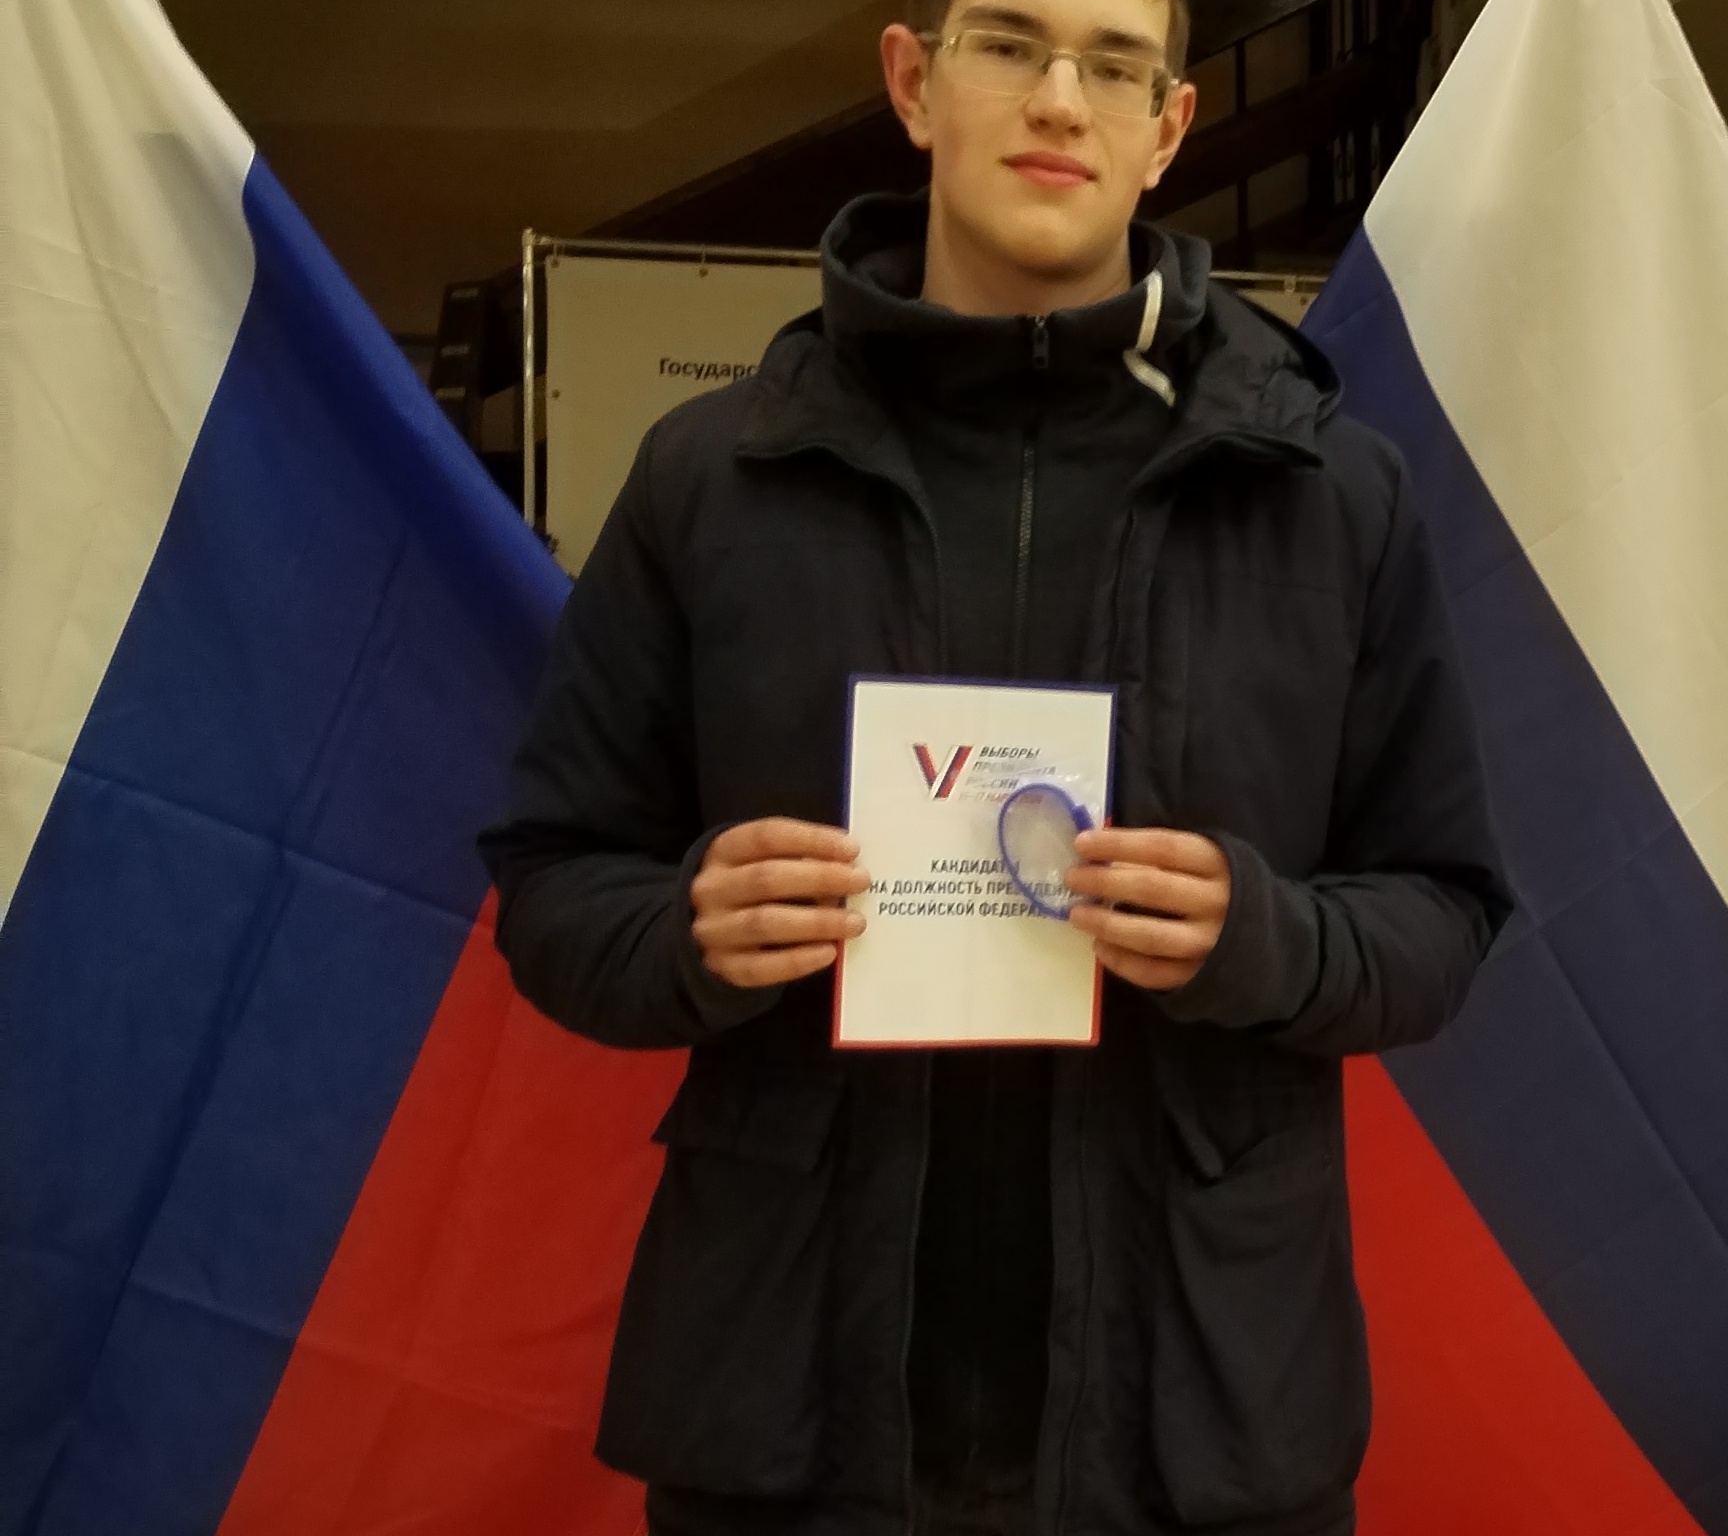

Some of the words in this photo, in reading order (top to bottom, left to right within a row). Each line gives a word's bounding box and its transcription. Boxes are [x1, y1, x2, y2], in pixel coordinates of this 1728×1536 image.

[979, 746, 1041, 760] ВЫБОРЫ
[869, 881, 888, 895] НА
[891, 880, 983, 896] ДОЛЖНОСТЬ
[878, 898, 975, 916] РОССИЙСКОЙ
[978, 901, 1048, 918] ФЕДЕРА
